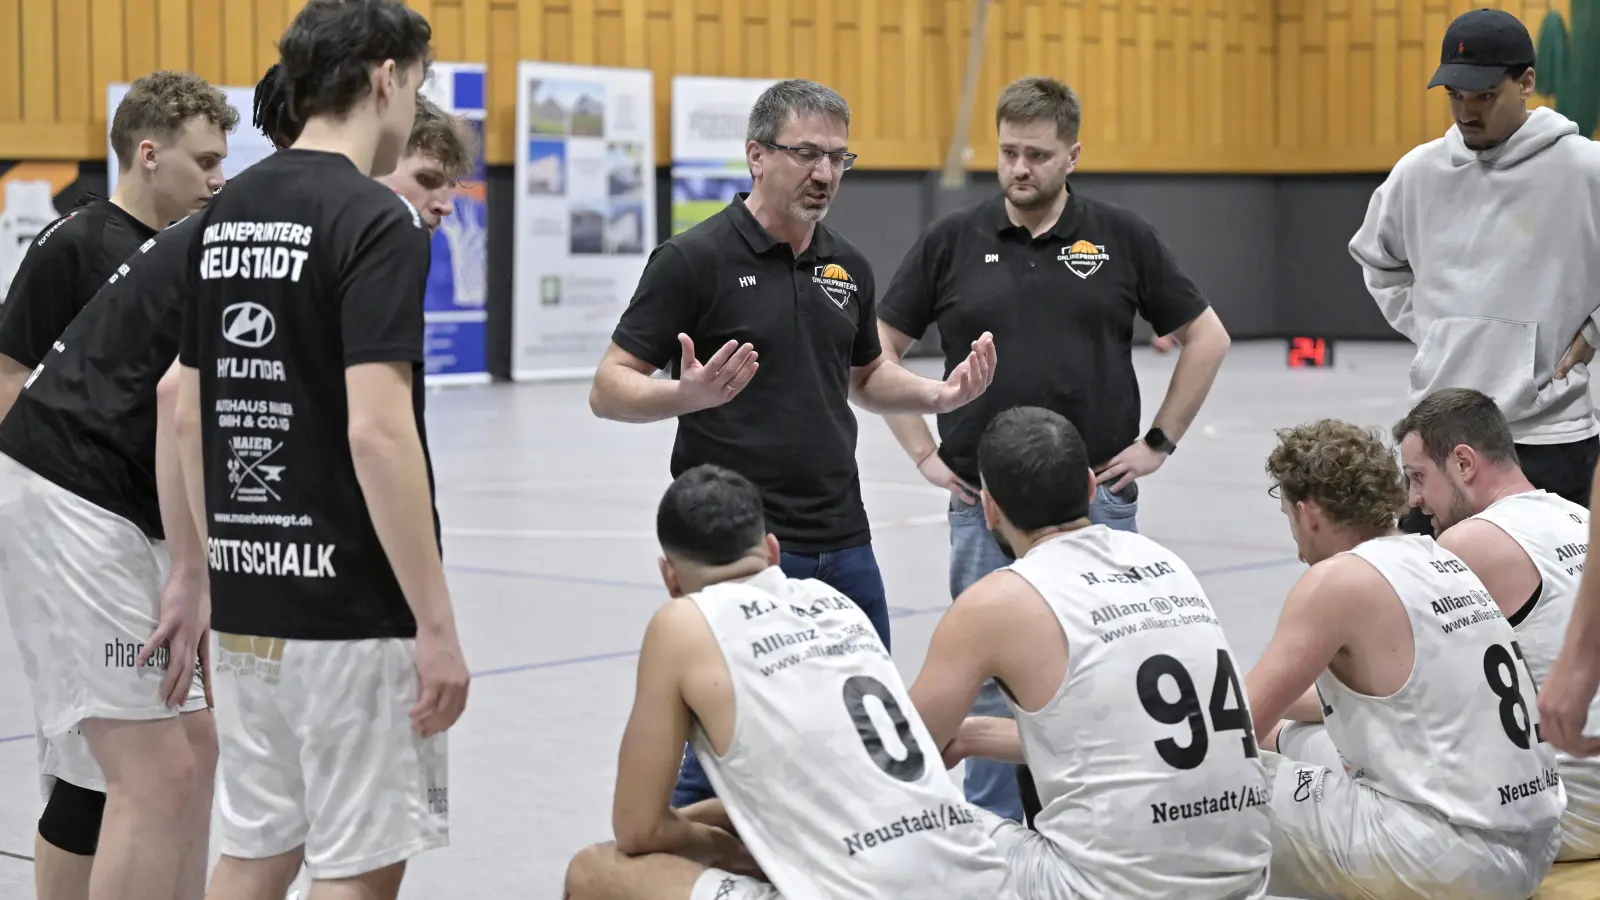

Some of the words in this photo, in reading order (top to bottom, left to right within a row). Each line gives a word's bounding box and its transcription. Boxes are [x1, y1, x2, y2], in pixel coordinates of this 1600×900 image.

[984, 253, 999, 264] DM
[739, 275, 757, 288] HW
[1288, 336, 1325, 367] 24
[243, 414, 255, 428] &
[207, 536, 336, 577] GOTTSCHALK
[1090, 601, 1151, 626] Allianz
[1431, 595, 1476, 616] Allianz
[751, 628, 820, 658] Allianz
[1136, 648, 1260, 770] 94
[843, 675, 926, 782] 0
